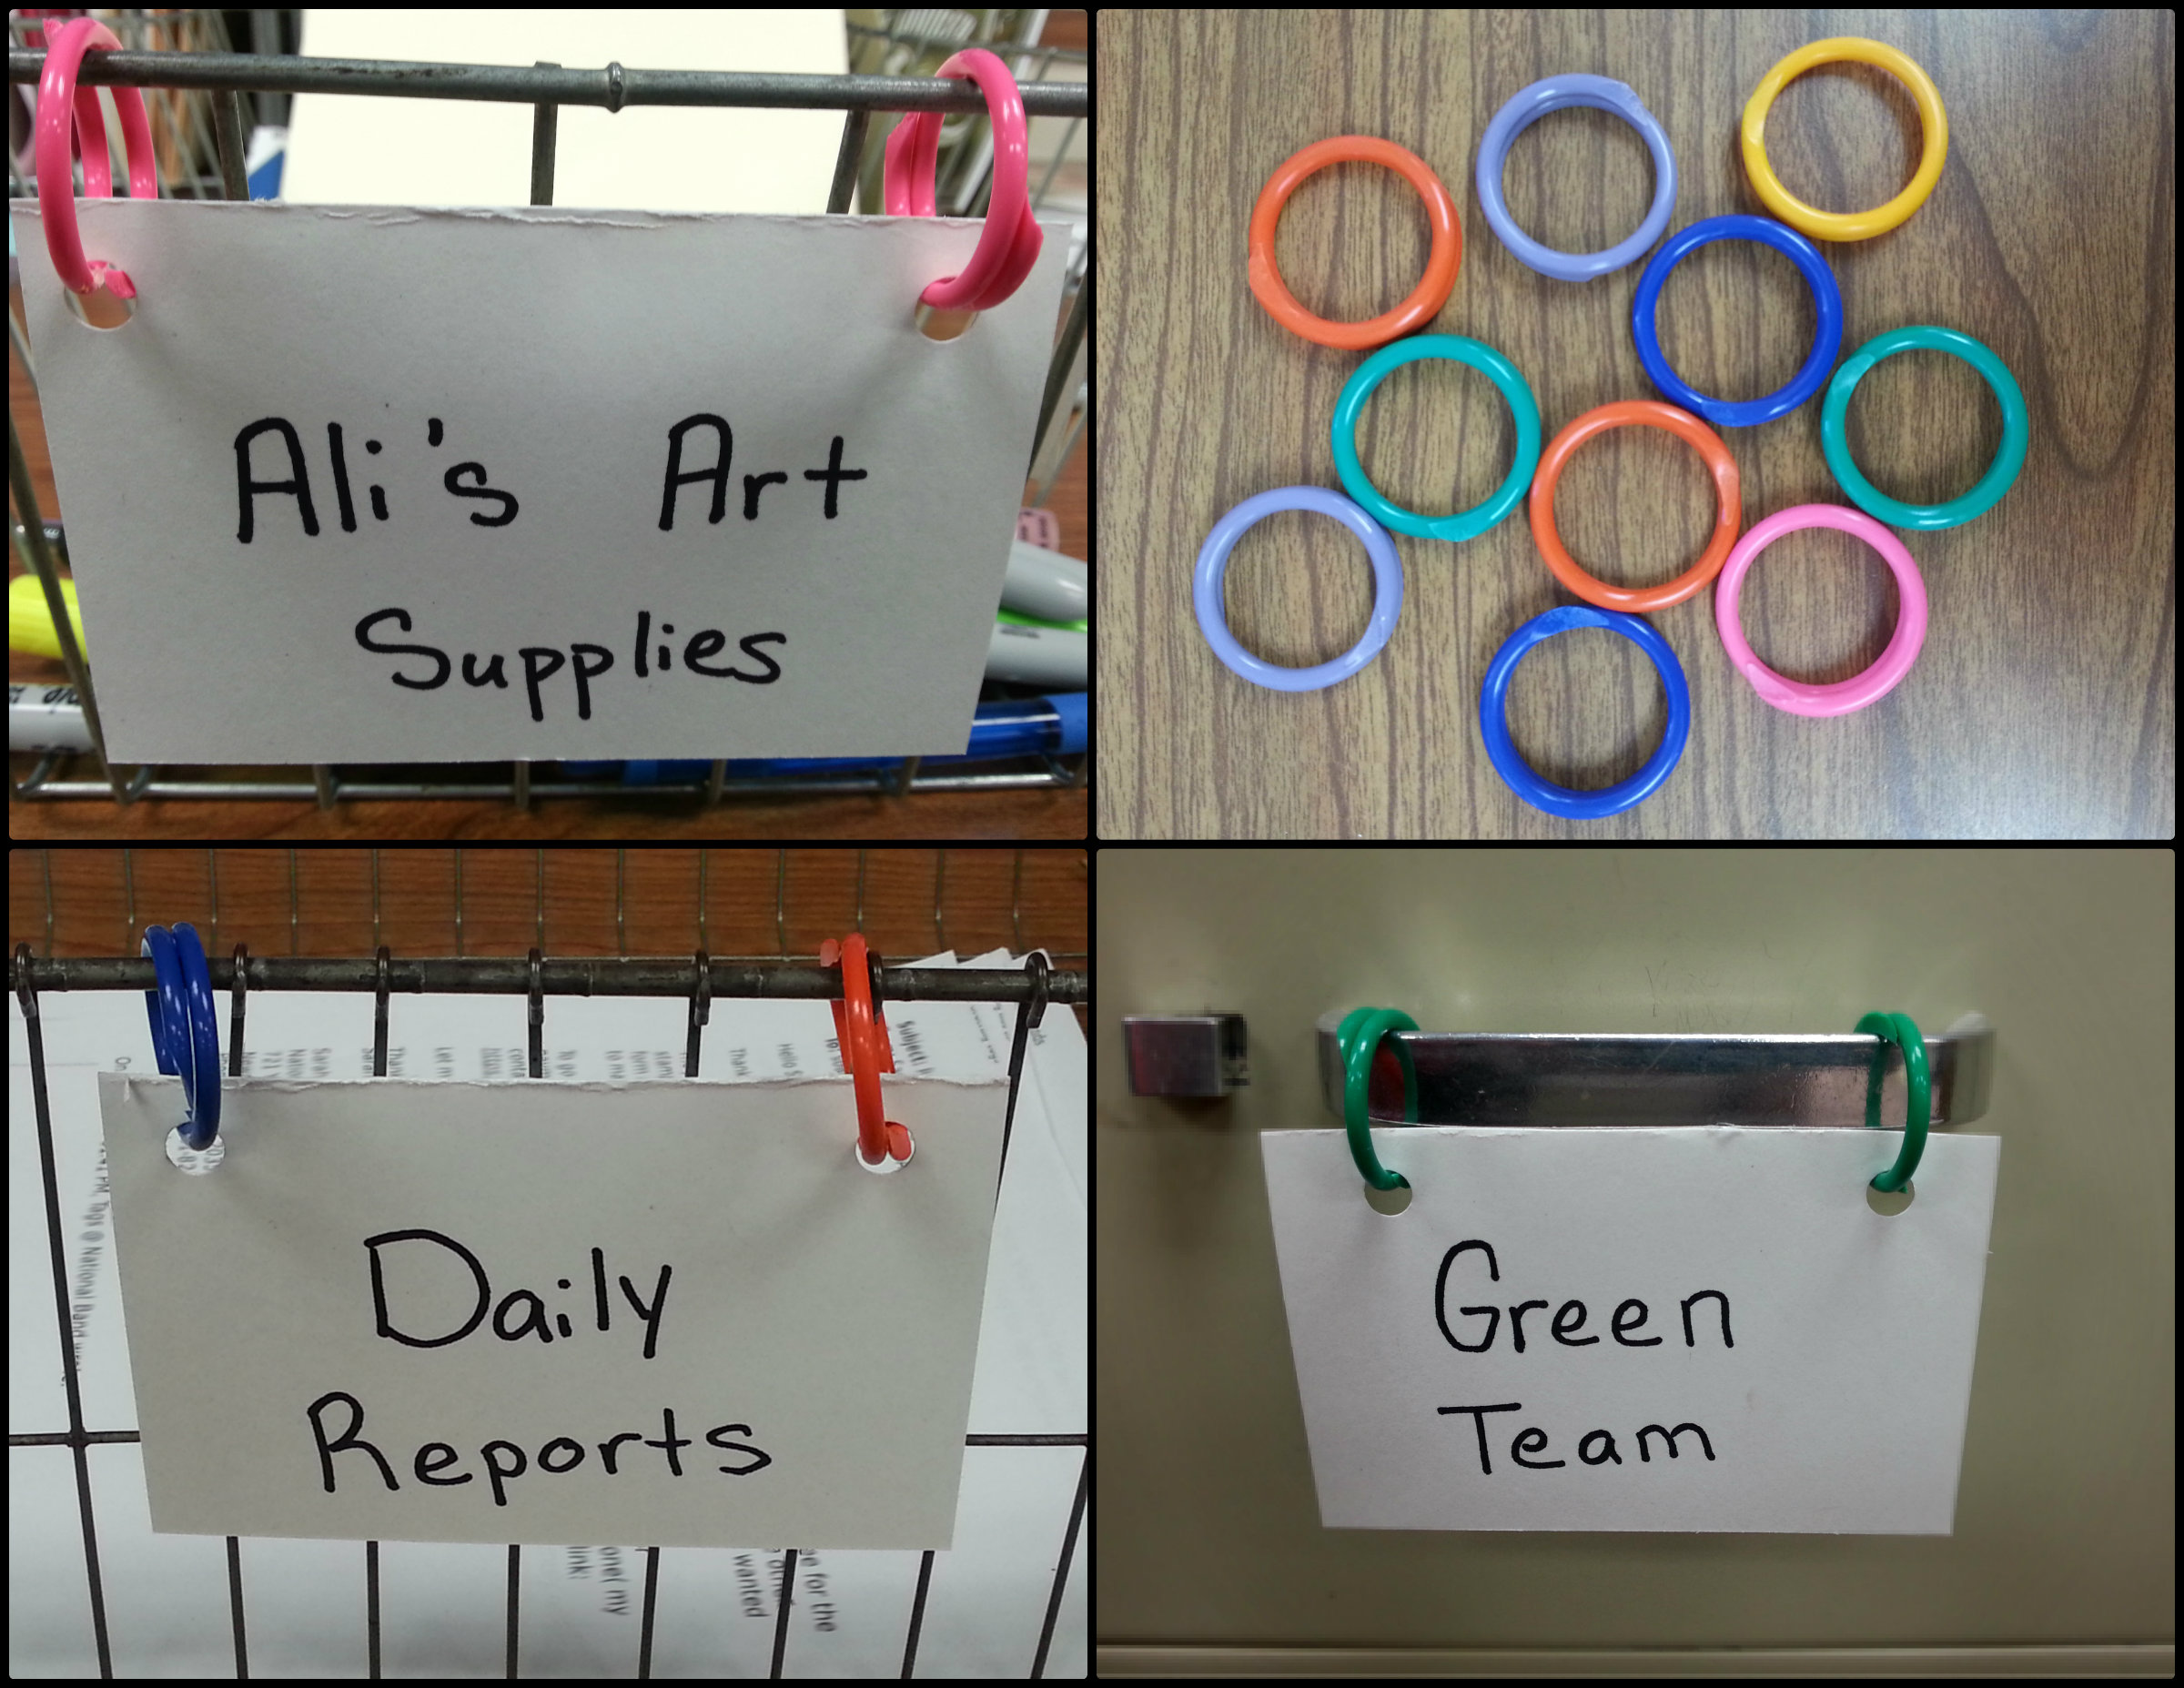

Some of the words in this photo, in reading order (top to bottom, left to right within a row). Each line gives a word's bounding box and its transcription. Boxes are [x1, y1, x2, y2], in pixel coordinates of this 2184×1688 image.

[233, 416, 520, 544] Ali's
[658, 412, 868, 532] Art
[354, 607, 787, 723] Supplies
[777, 1043, 799, 1068] Hello
[73, 1246, 105, 1299] National
[363, 1228, 672, 1359] Daily
[1434, 1238, 1734, 1354] Green
[307, 1391, 773, 1507] Reports
[1436, 1402, 1716, 1476] Team
[733, 1553, 771, 1618] wanted
[811, 1602, 839, 1632] the
